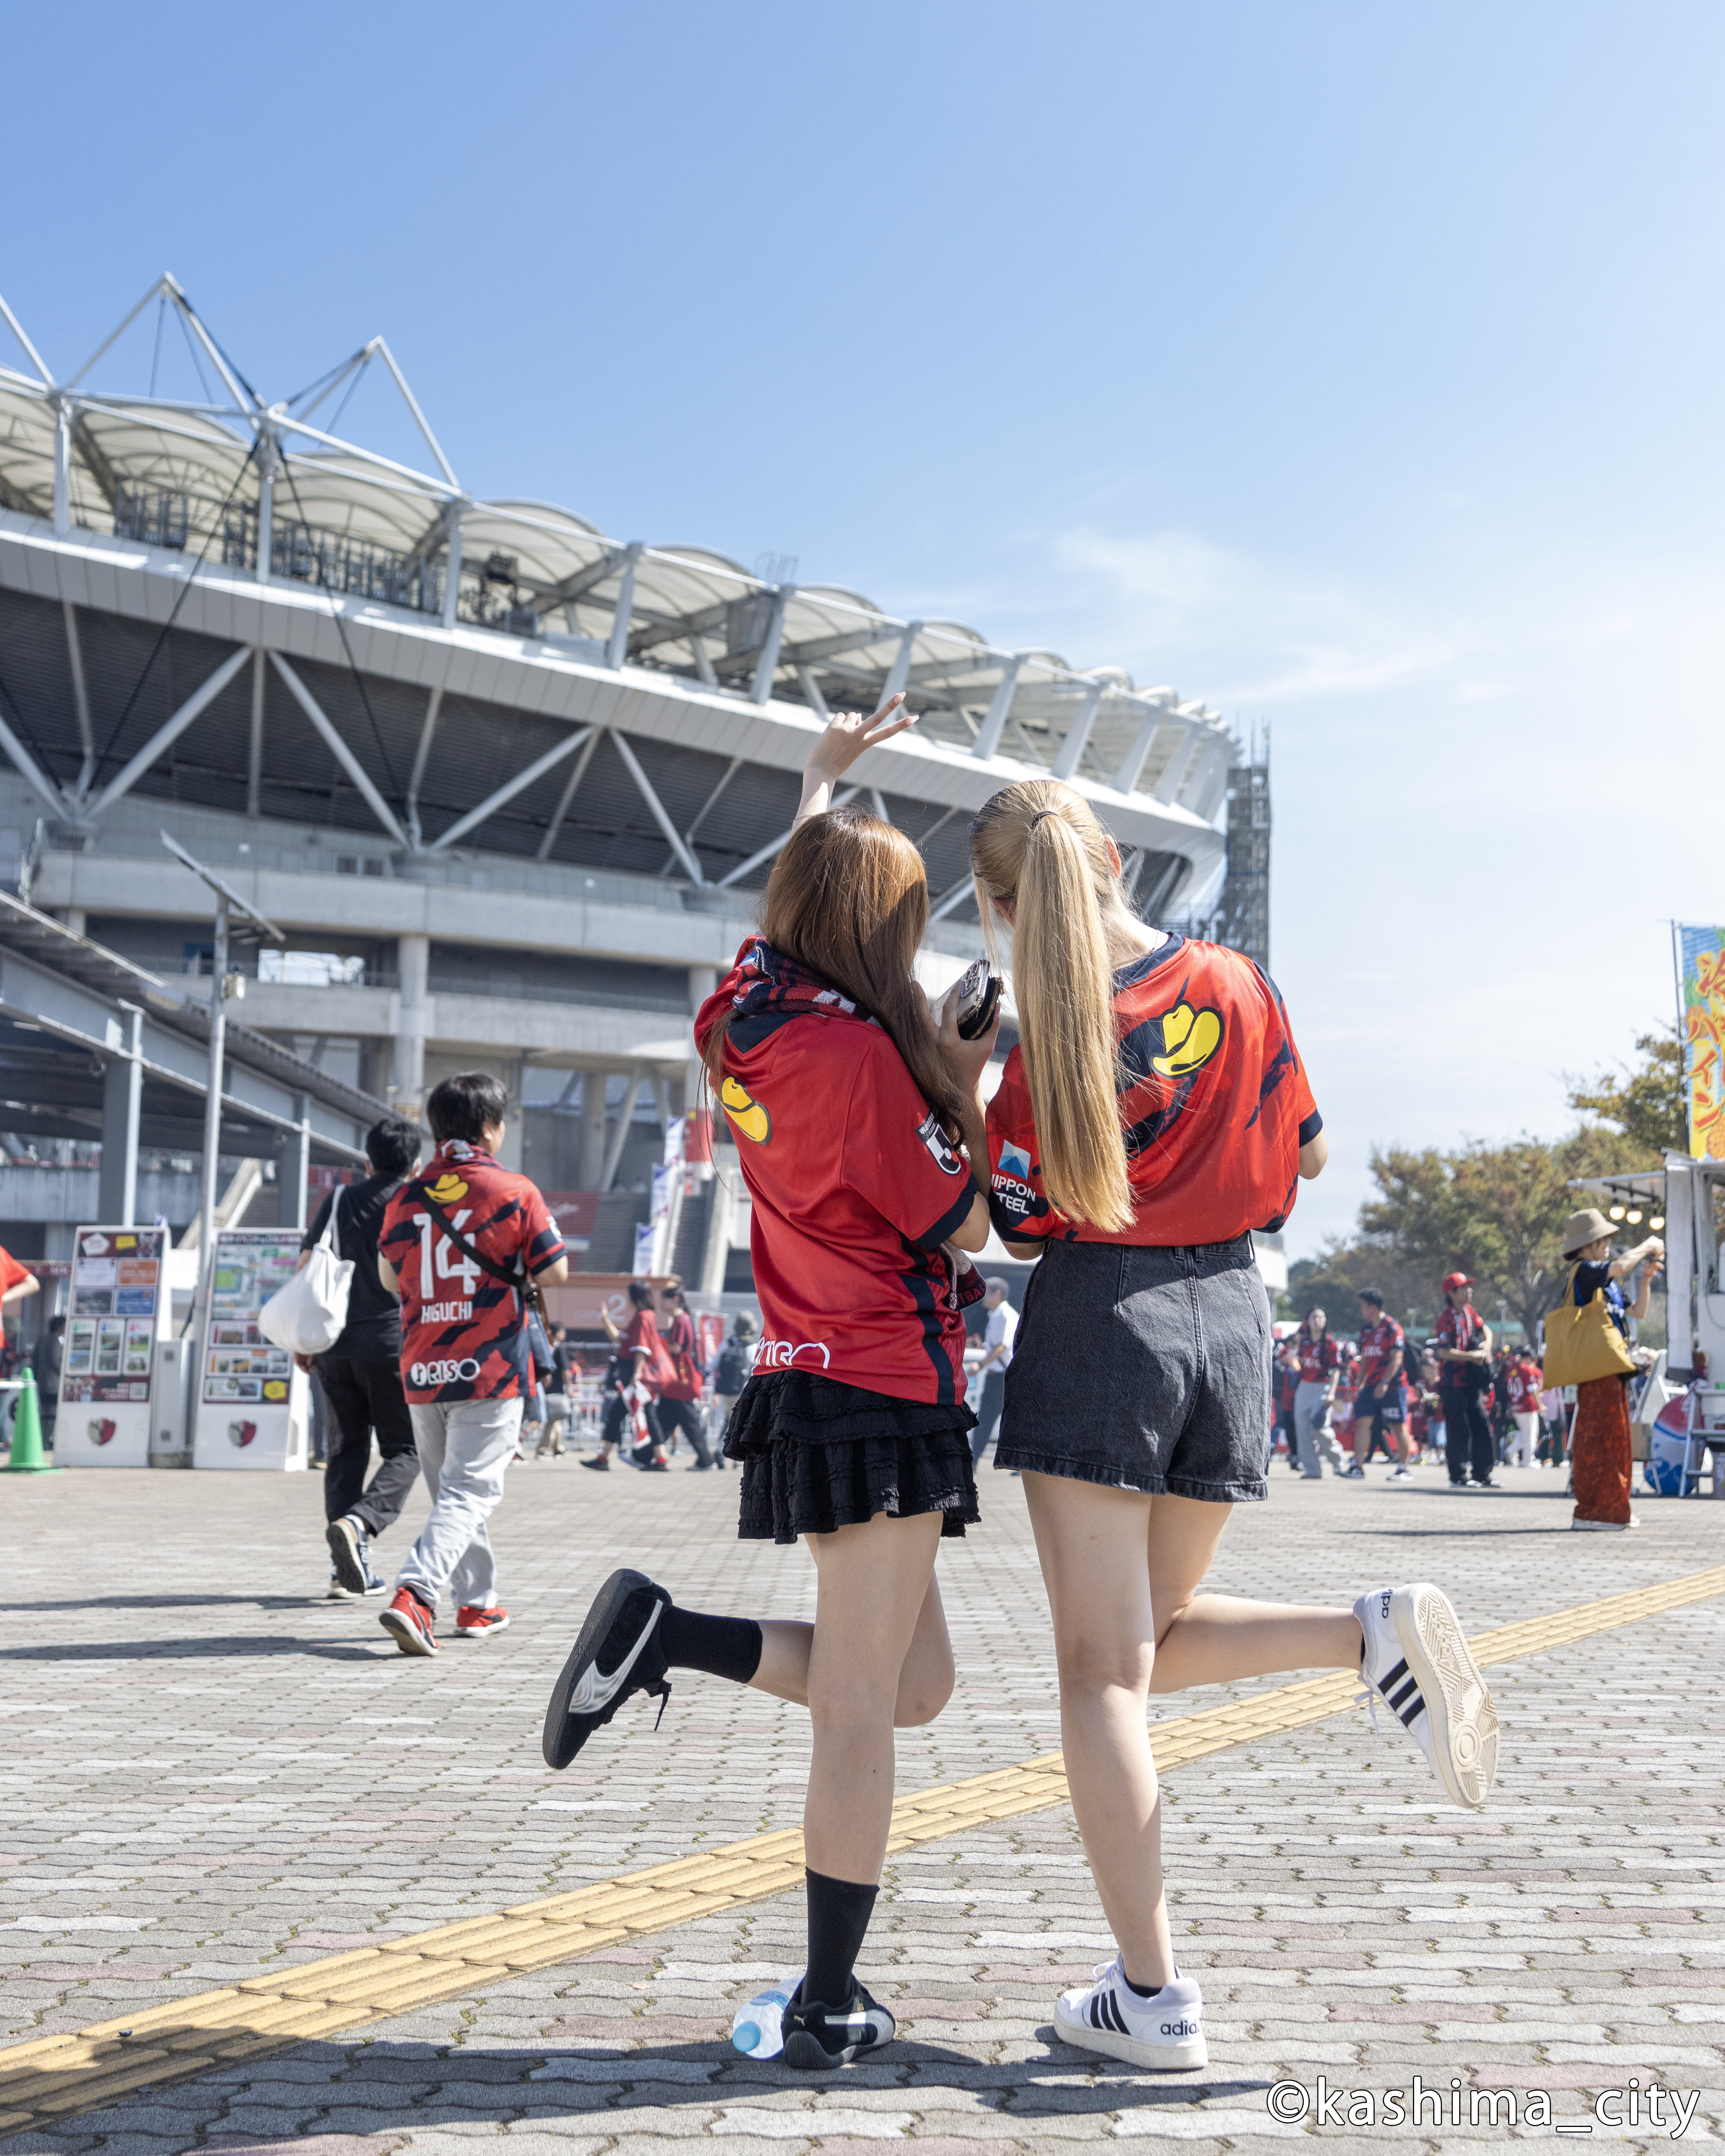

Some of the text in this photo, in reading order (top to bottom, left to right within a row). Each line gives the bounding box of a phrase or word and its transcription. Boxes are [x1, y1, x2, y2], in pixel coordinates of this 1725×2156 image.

[993, 1190, 1029, 1215] TEEL
[413, 1209, 481, 1299] 14
[421, 1300, 473, 1324] HIGUCHI
[1380, 1587, 1393, 1618] adi
[1160, 2019, 1200, 2035] adid
